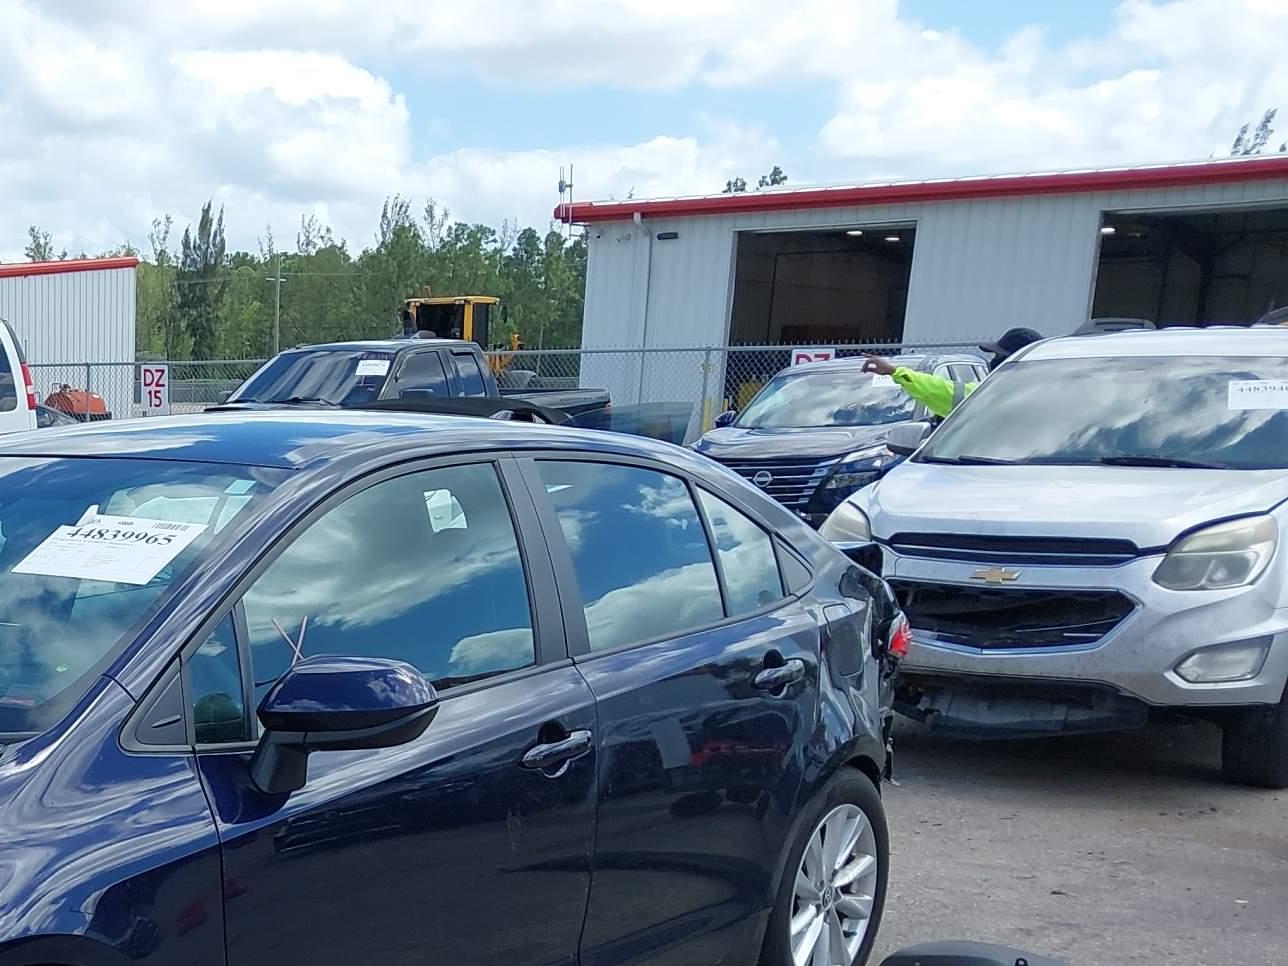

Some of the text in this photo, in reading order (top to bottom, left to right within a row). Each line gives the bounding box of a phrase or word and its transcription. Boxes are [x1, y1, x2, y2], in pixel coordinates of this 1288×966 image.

[143, 368, 166, 388] DZ
[147, 389, 163, 408] 15
[66, 527, 178, 546] 44839965
